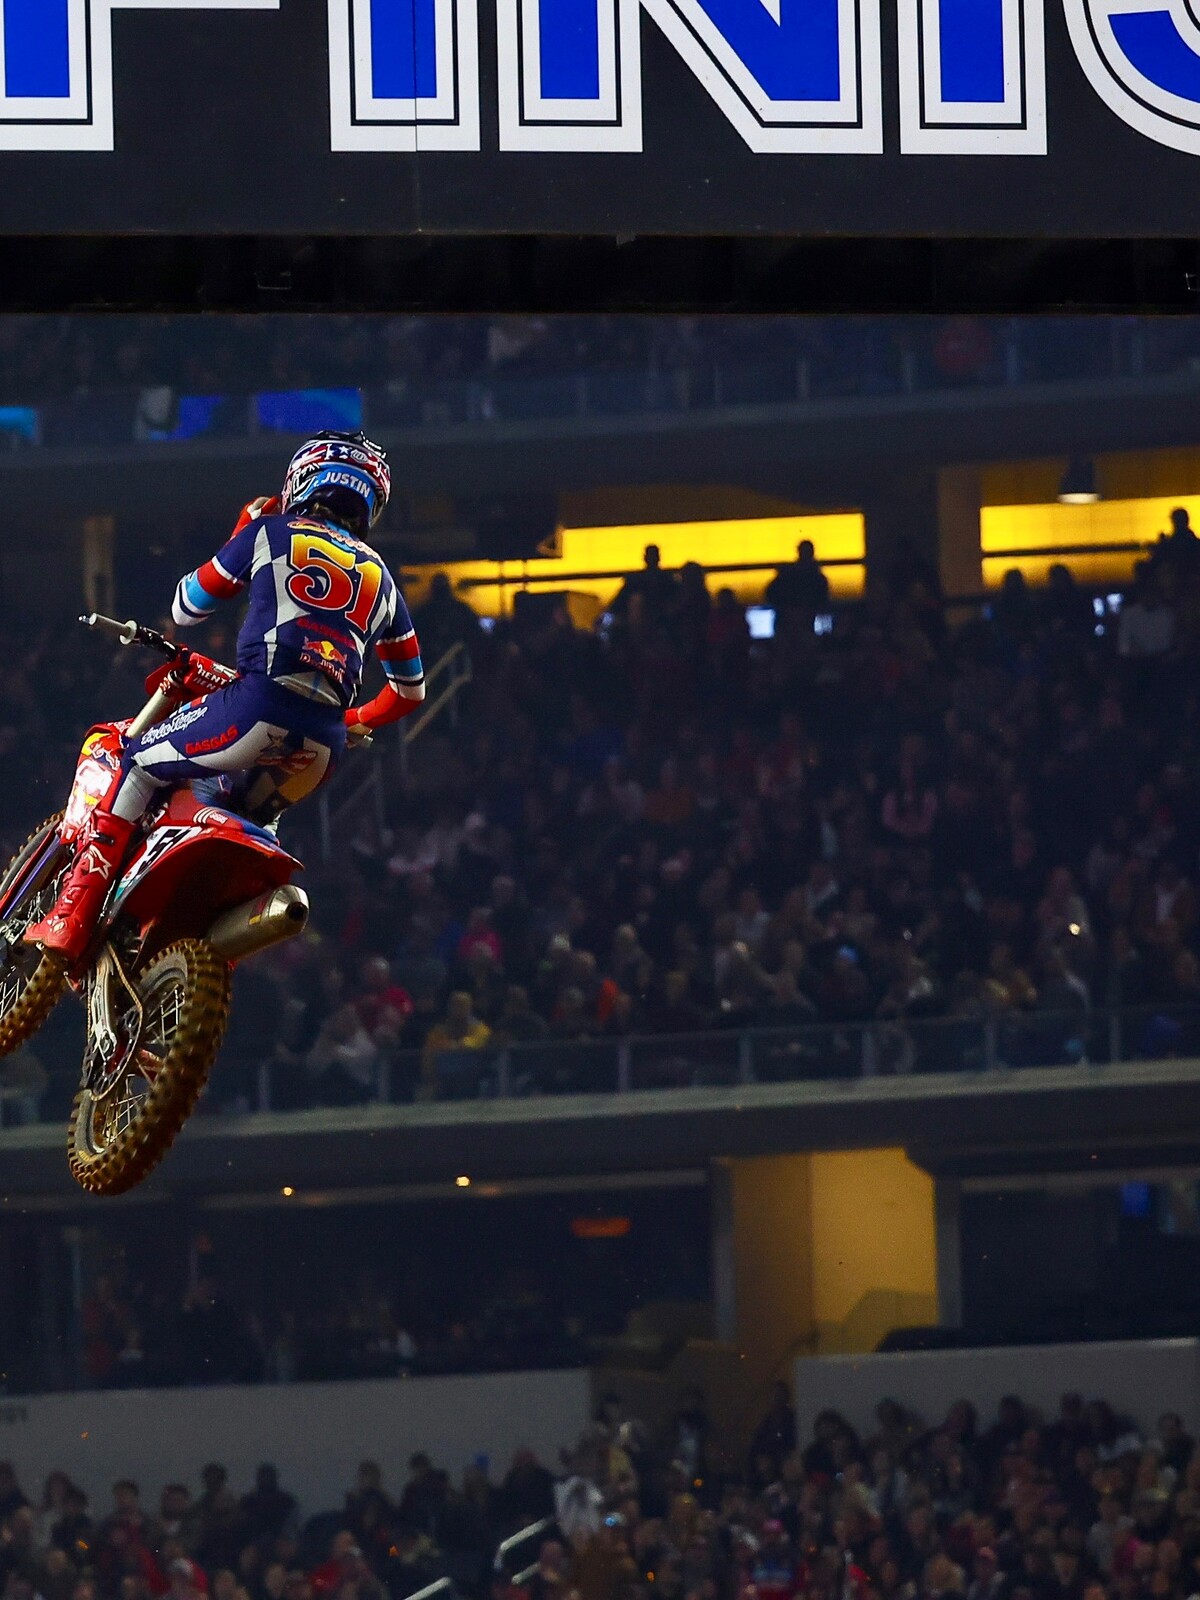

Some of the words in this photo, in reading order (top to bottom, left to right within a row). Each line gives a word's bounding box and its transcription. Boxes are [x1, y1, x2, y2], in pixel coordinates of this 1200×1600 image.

[320, 471, 371, 499] JUSTIN
[288, 533, 382, 635] 51
[185, 724, 239, 755] GASGAS
